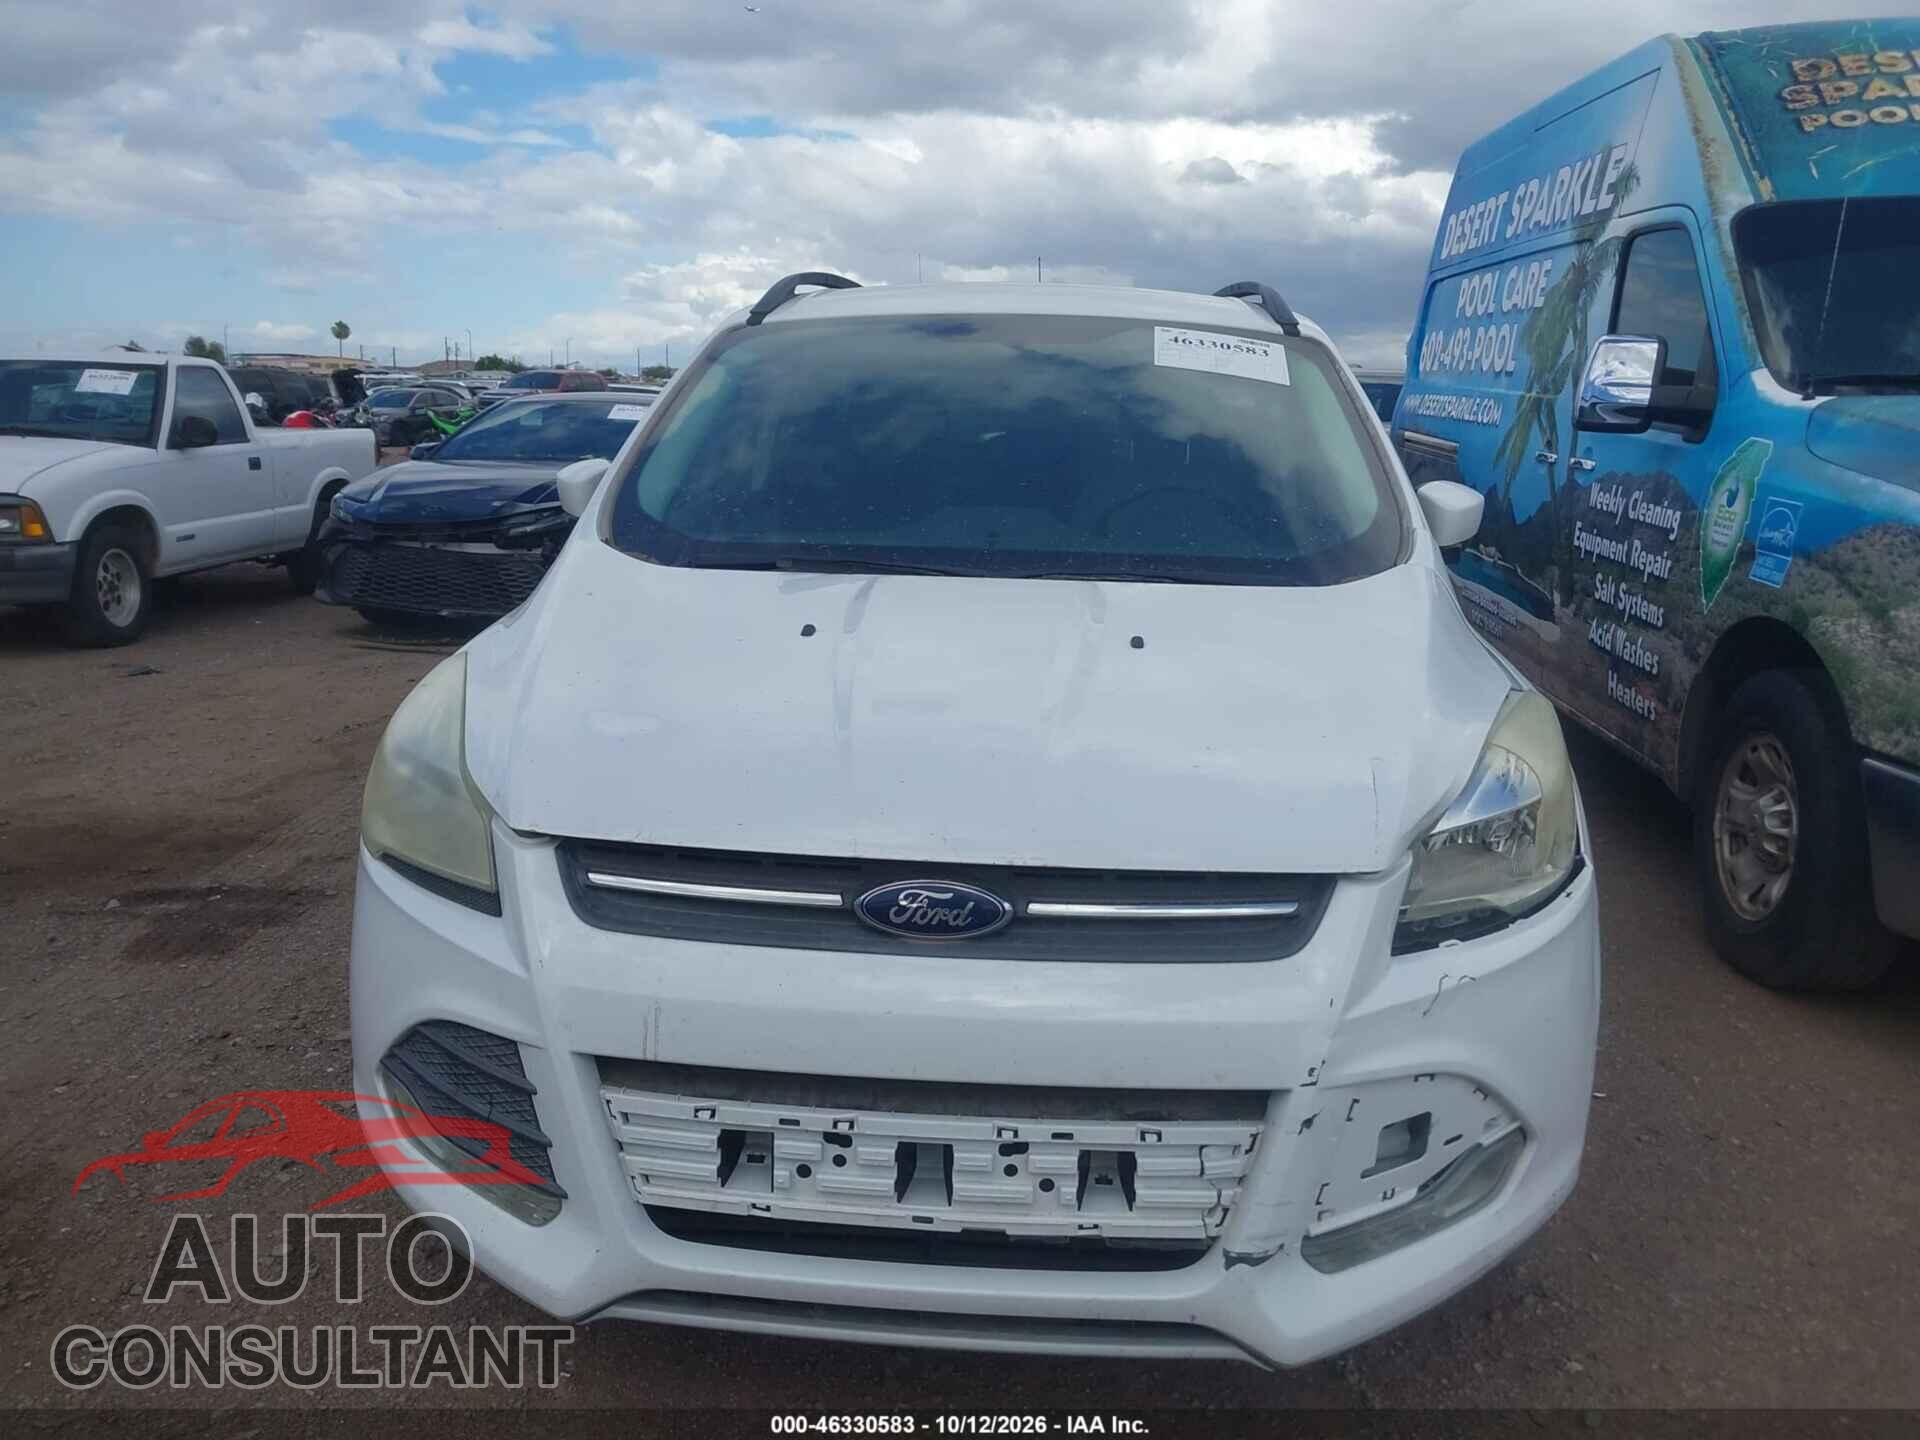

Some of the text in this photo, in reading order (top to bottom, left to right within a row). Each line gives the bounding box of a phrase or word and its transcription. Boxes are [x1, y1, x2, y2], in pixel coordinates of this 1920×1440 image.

[1792, 50, 1920, 81] DES
[1440, 143, 1627, 260] DESERT SPARKLE
[1456, 259, 1552, 318] POOL CARE
[1419, 323, 1518, 373] 602-493-POOL
[1589, 481, 1681, 540] Weekly Cleaning
[1573, 520, 1672, 583] Equipment Repair
[1594, 572, 1664, 628] Salt Systems
[1588, 618, 1659, 675] Acid Washes
[1607, 670, 1656, 720] Heaters
[889, 889, 975, 927] Ford
